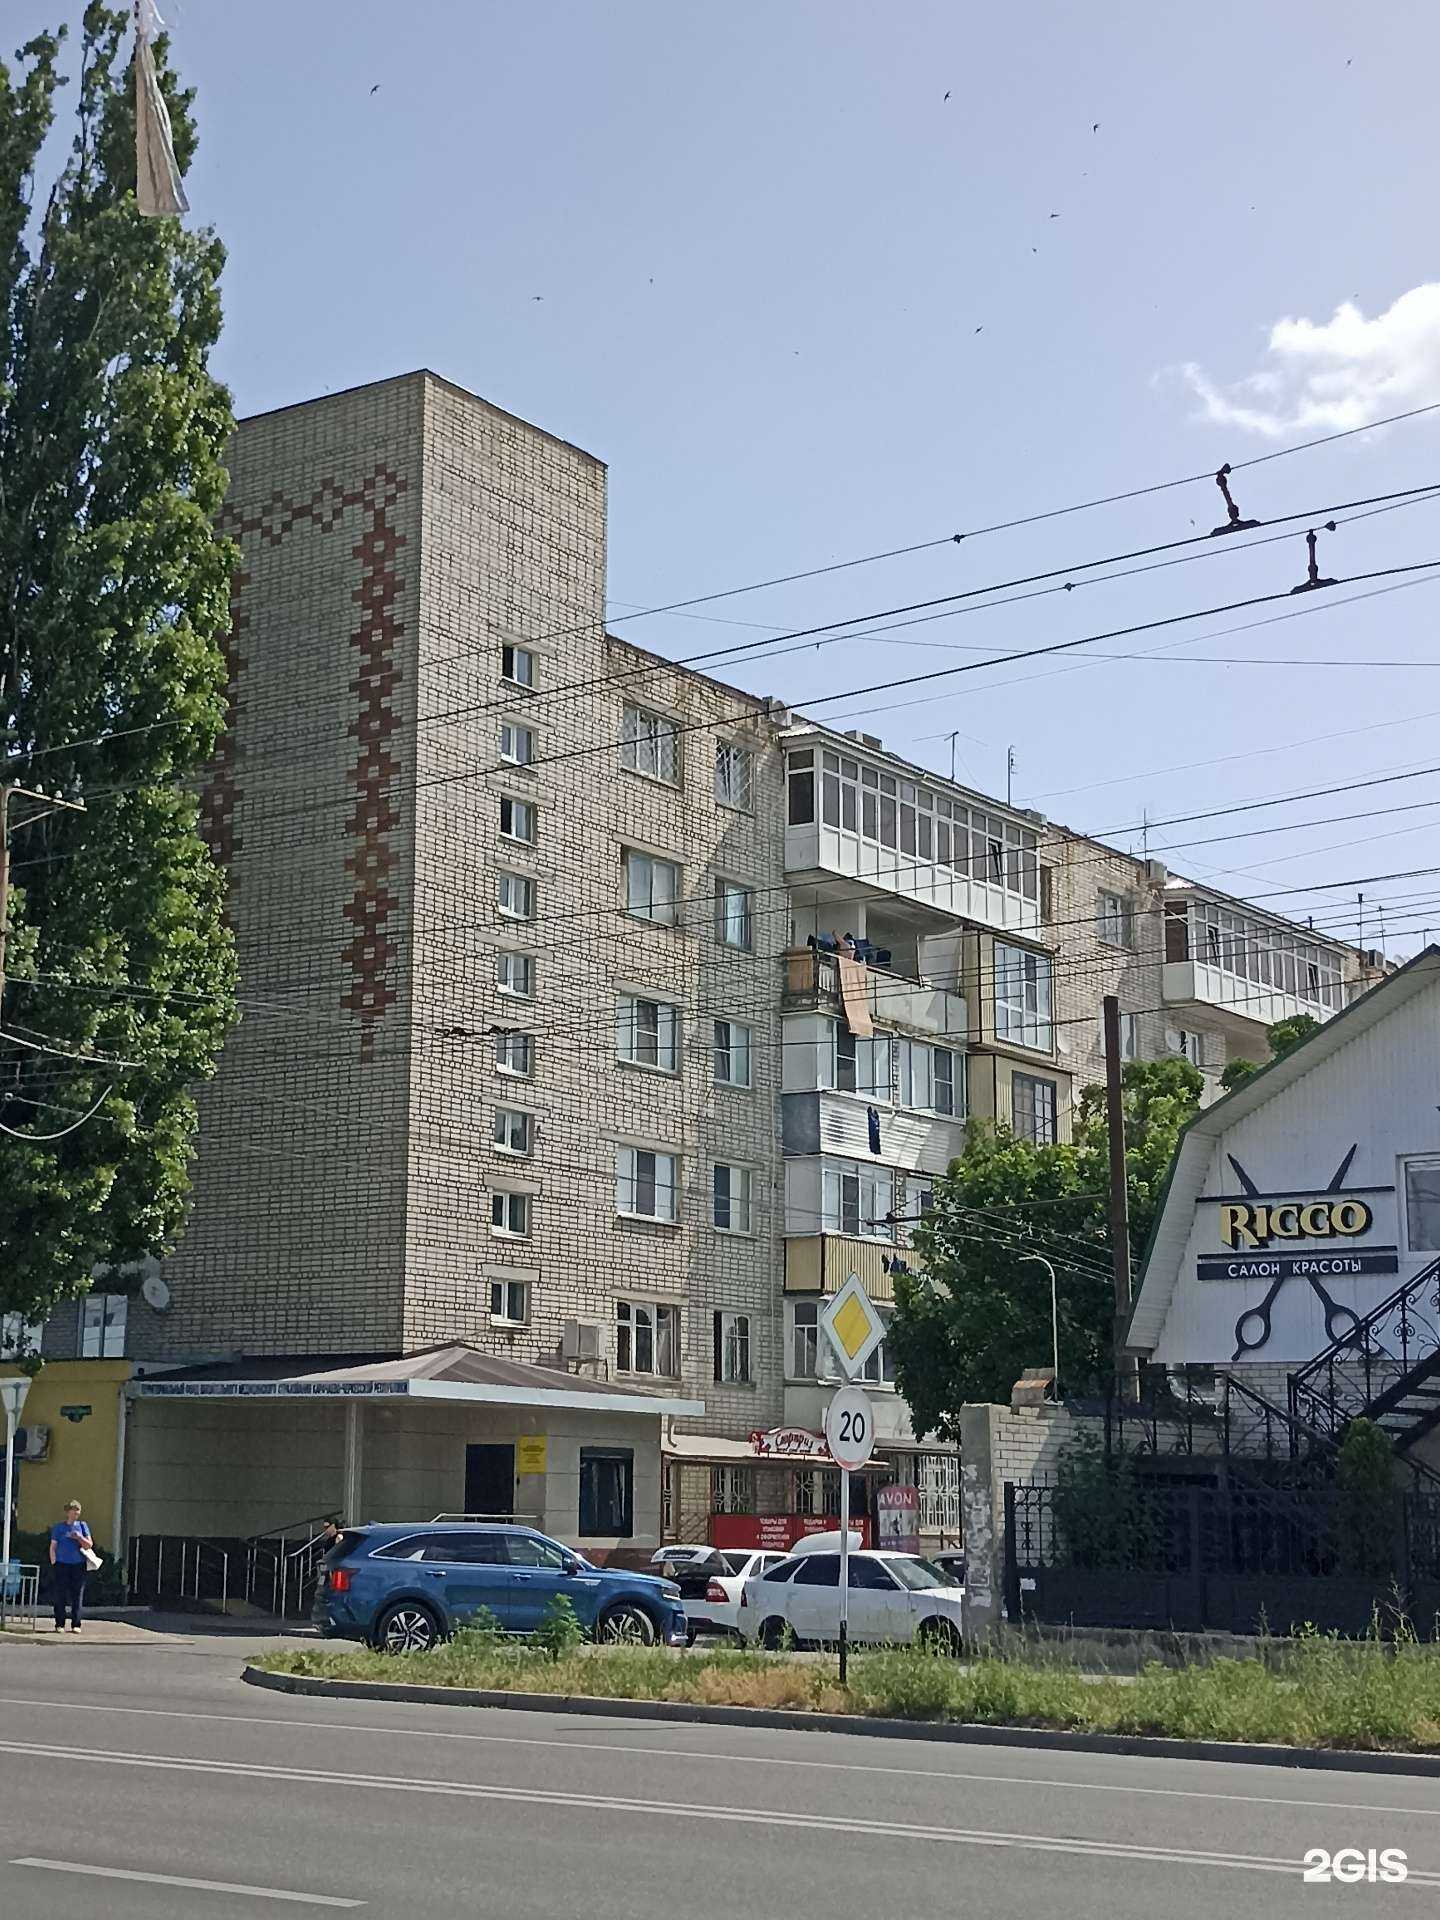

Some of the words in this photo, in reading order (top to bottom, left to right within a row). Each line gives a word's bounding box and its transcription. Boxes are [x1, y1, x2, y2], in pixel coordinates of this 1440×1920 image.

[1221, 1200, 1373, 1250] RICCO
[1228, 1263, 1280, 1277] САЛОН
[1292, 1259, 1361, 1275] КРАСОТЫ
[839, 1410, 865, 1443] 20
[878, 1491, 912, 1505] AVON
